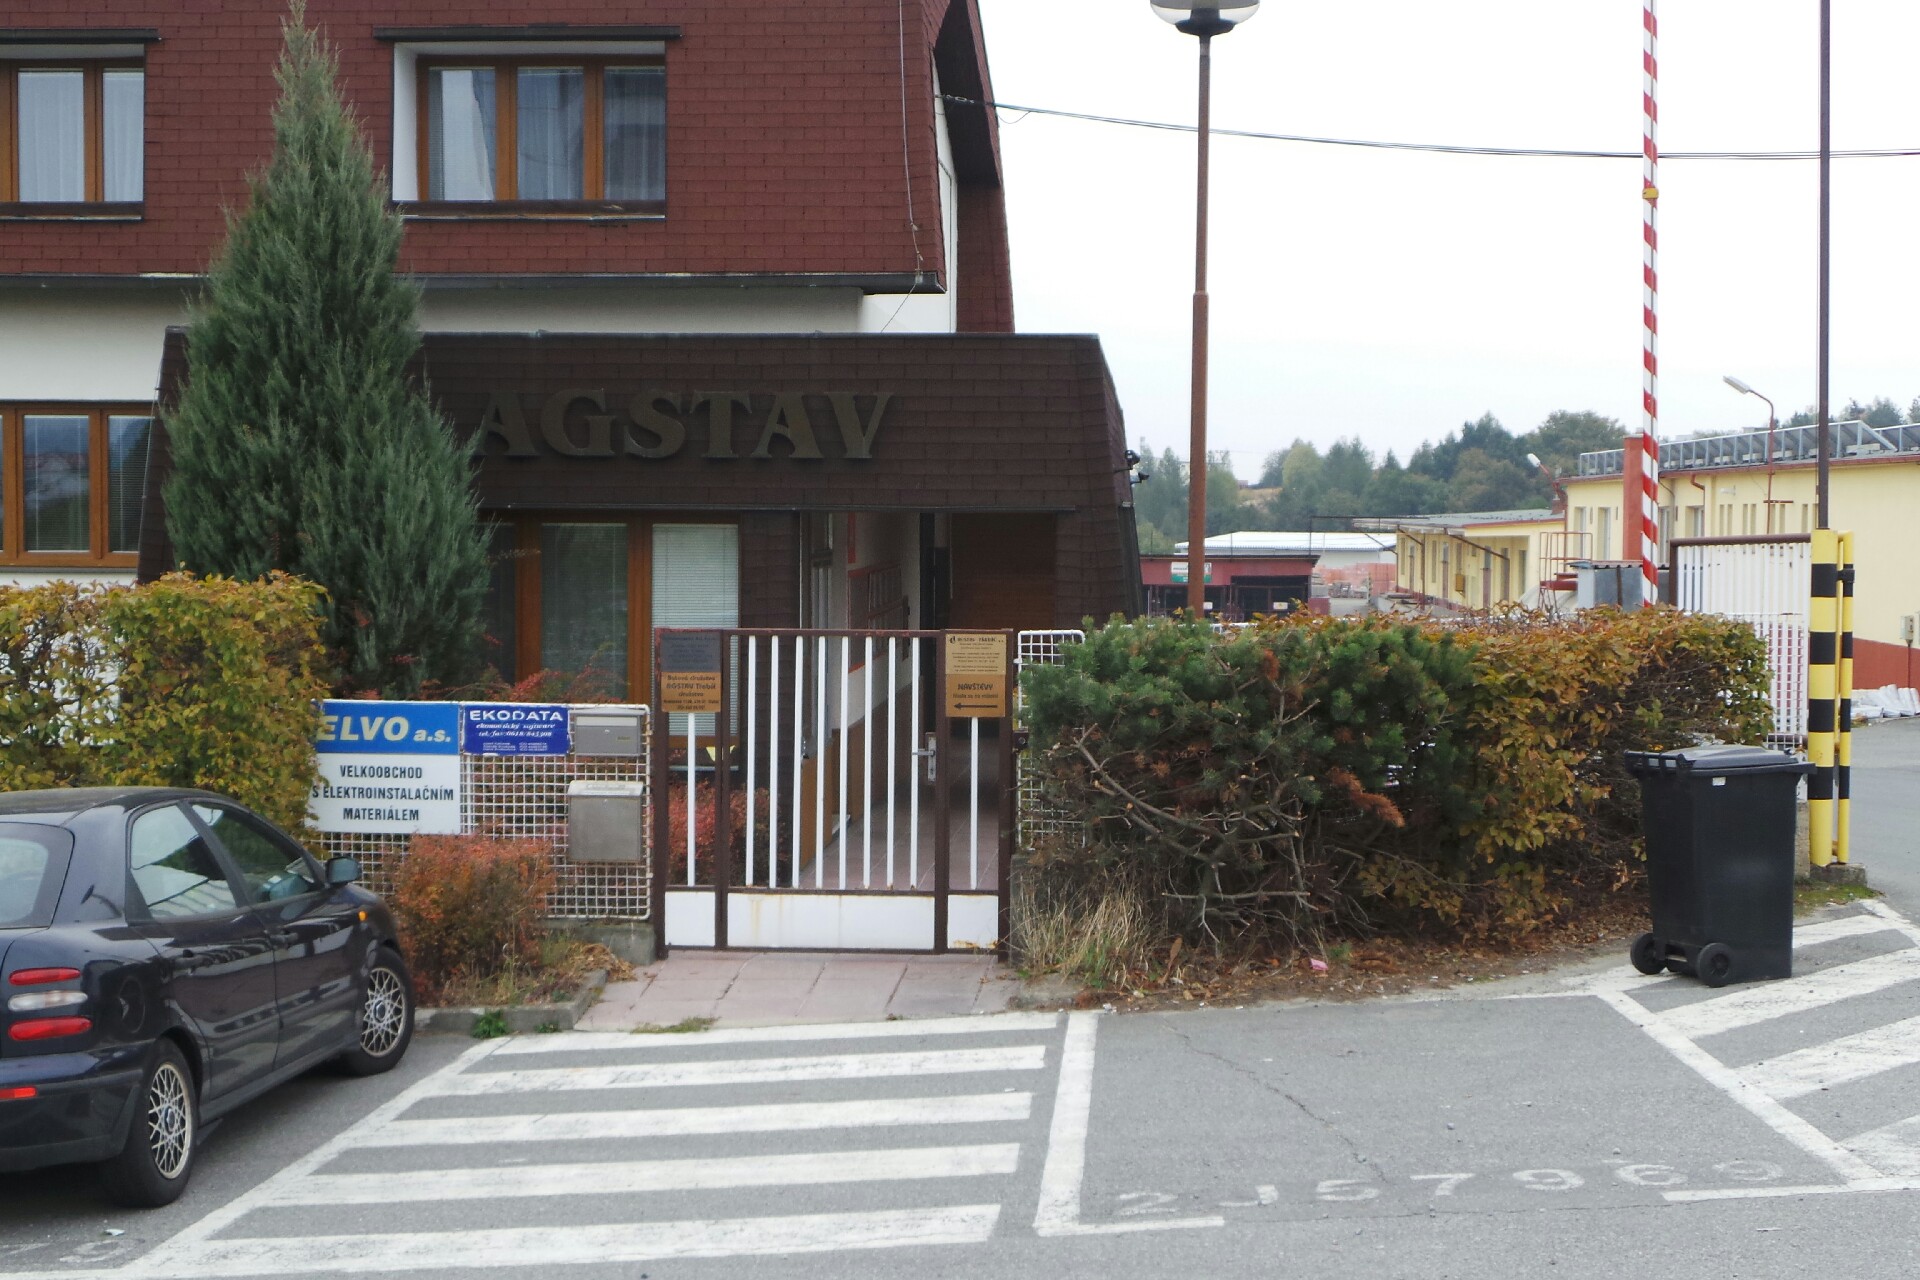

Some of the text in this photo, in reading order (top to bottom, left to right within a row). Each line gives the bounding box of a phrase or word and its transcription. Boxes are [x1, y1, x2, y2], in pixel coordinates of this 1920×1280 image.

[471, 387, 894, 459] AGSTAV
[469, 709, 563, 721] EKODATA
[316, 715, 451, 742] ELVO a.s.
[340, 765, 423, 779] VELKOOBCHOD
[323, 784, 454, 801] ELEKTROINSTALAČNÍM
[343, 805, 420, 821] MATERIÁLEM
